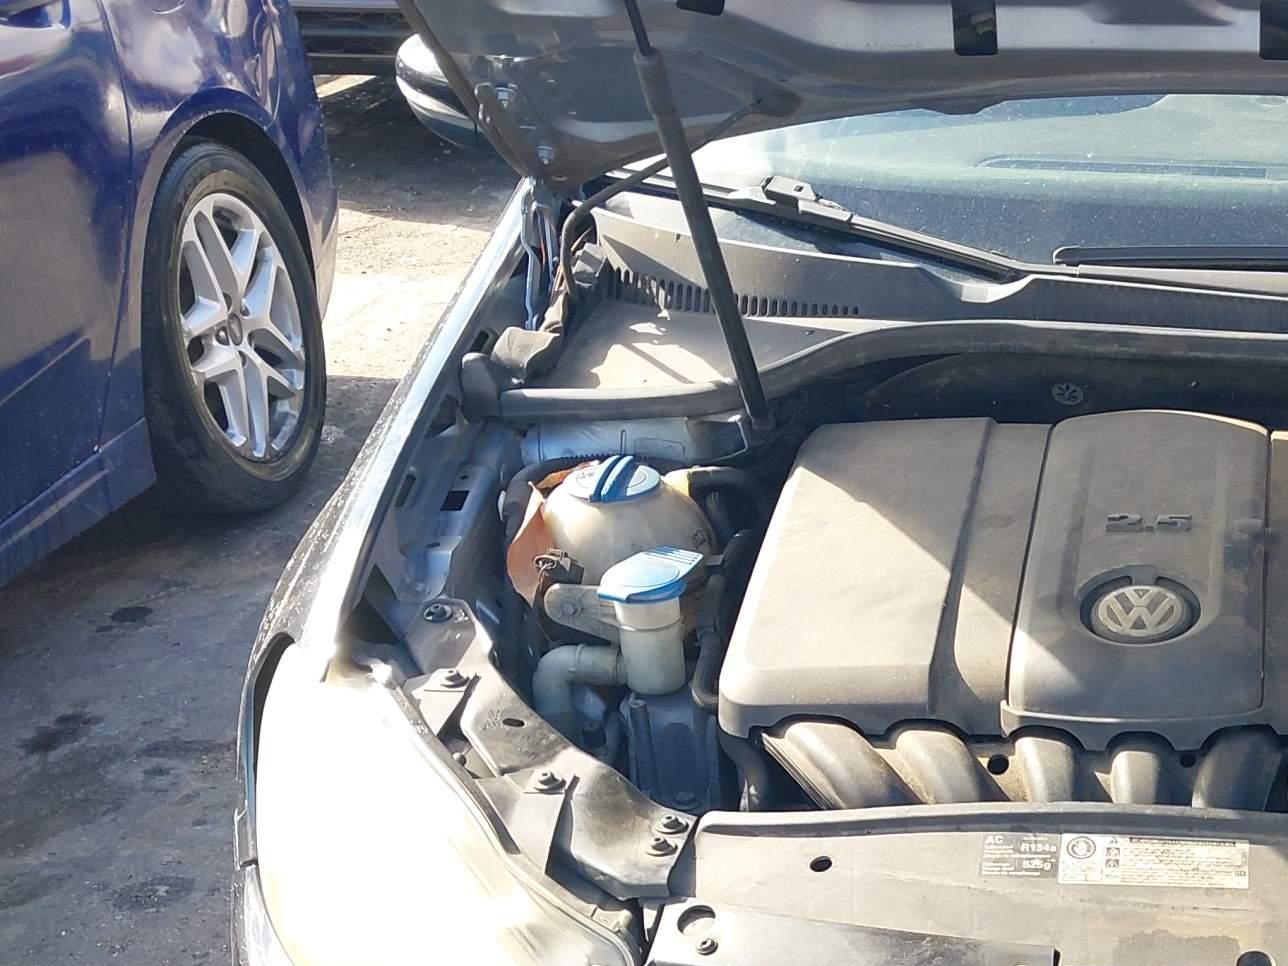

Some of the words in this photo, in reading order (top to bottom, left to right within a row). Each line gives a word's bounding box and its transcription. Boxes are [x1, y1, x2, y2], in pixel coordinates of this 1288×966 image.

[1105, 512, 1193, 533] 2.5
[1100, 586, 1184, 636] VW
[984, 835, 1004, 845] AC
